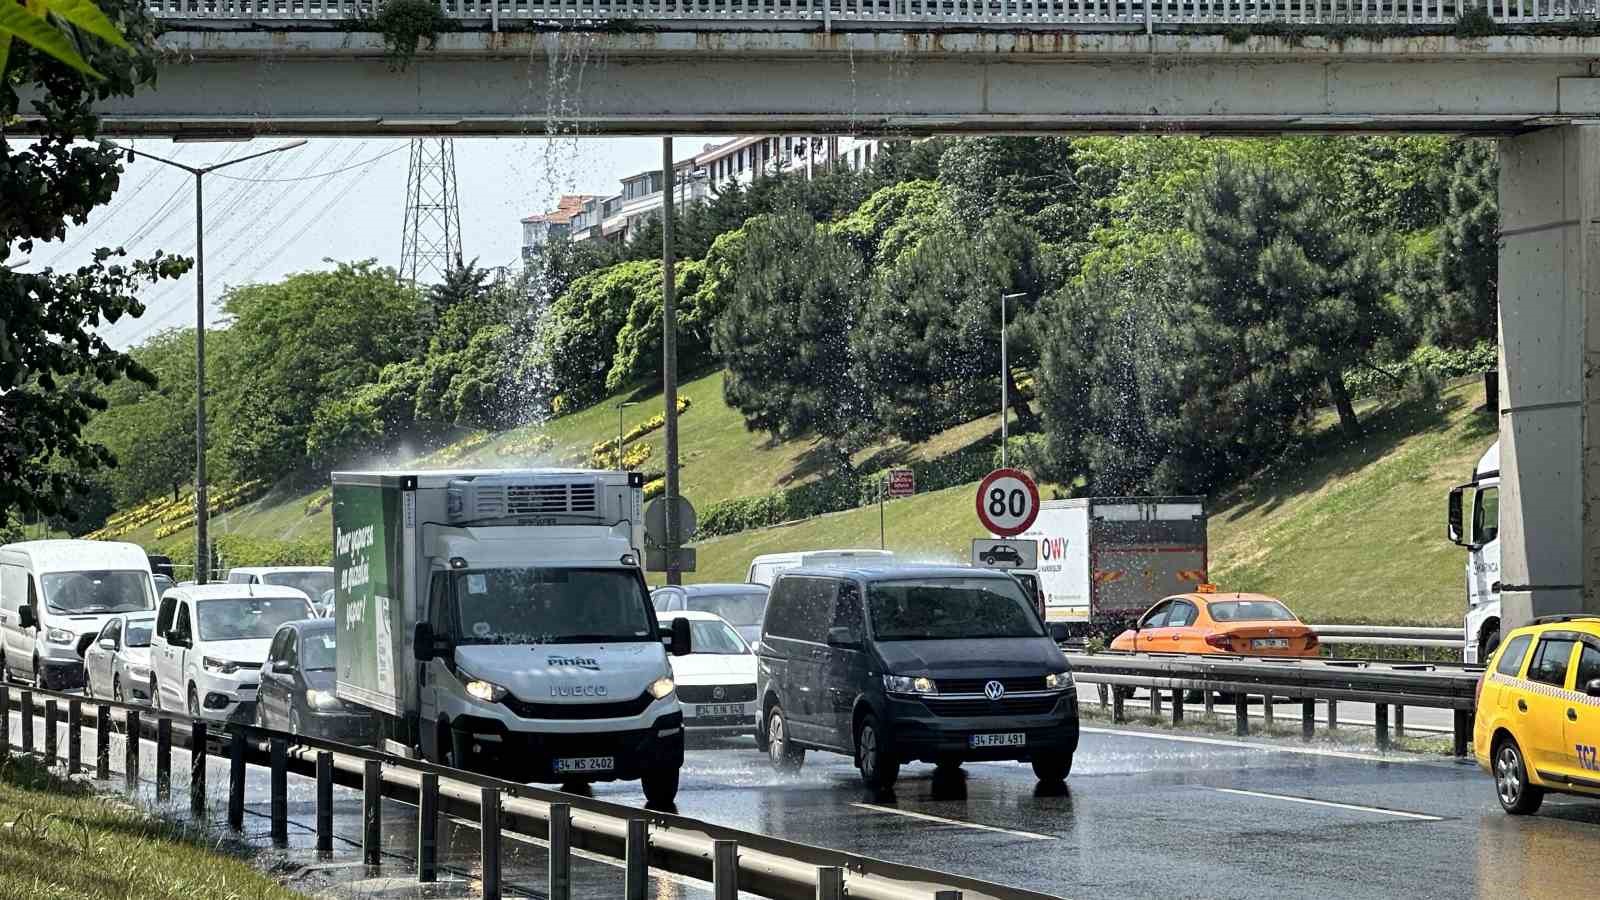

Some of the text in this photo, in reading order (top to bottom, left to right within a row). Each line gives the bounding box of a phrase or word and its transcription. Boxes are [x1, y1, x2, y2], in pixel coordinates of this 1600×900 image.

[989, 488, 1026, 517] 80
[1037, 537, 1069, 560] OWY
[547, 655, 600, 670] PINAR
[550, 685, 608, 697] IVECO
[975, 734, 1023, 745] 34 FPU 491
[559, 758, 612, 769] 34 NS 2402
